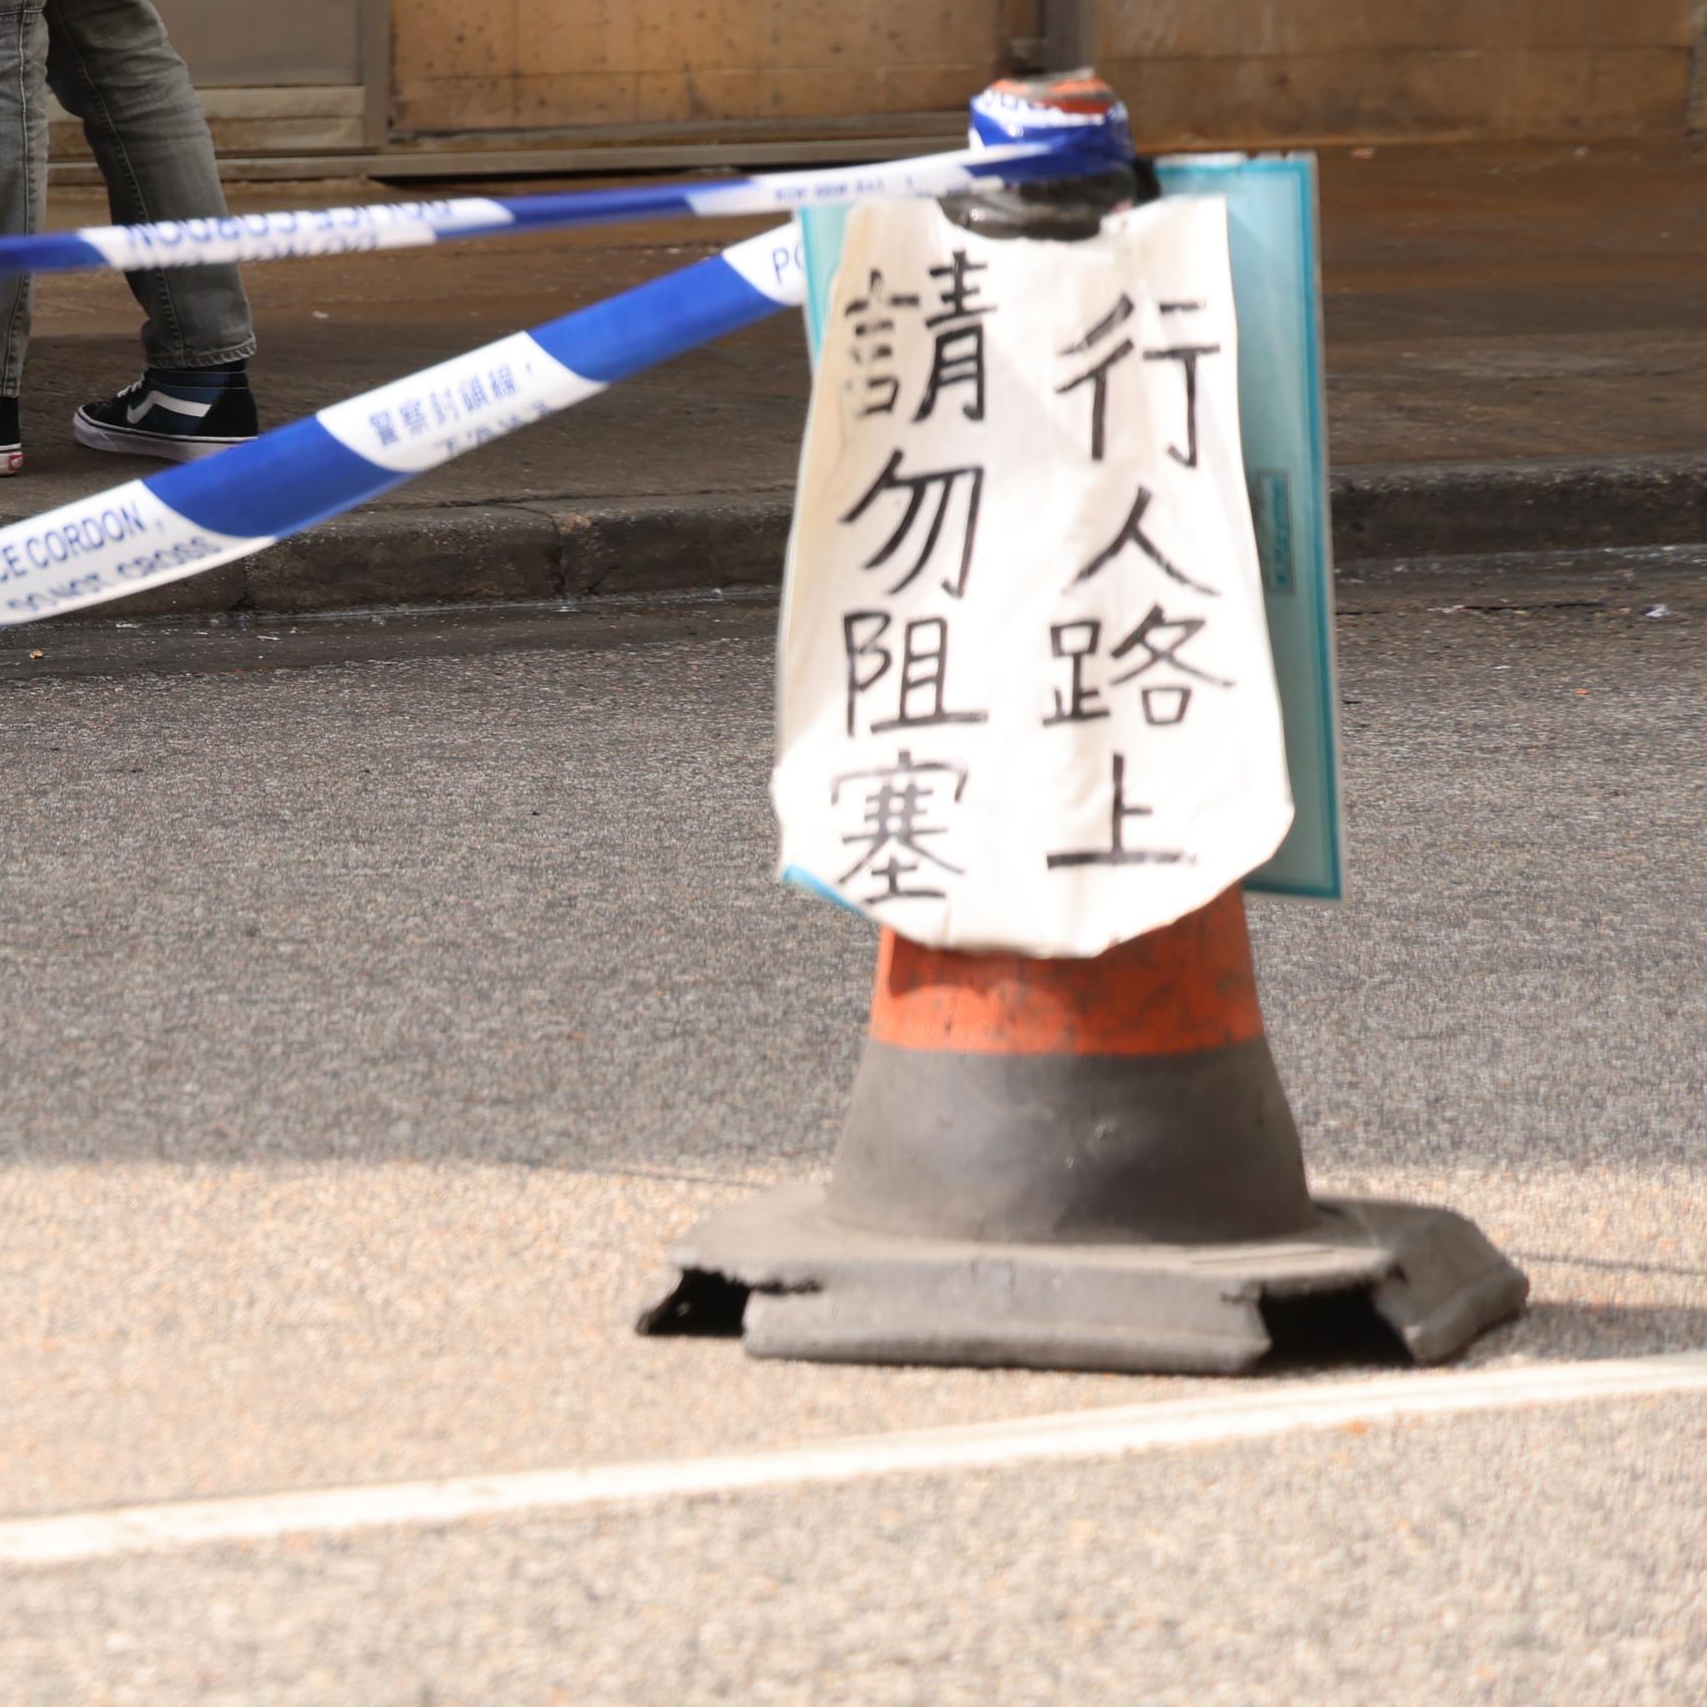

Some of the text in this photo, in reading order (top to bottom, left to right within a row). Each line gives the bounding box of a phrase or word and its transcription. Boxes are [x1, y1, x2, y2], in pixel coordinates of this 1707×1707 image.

[830, 249, 1000, 907] 請勿阻塞
[1040, 290, 1238, 869] 行人路上
